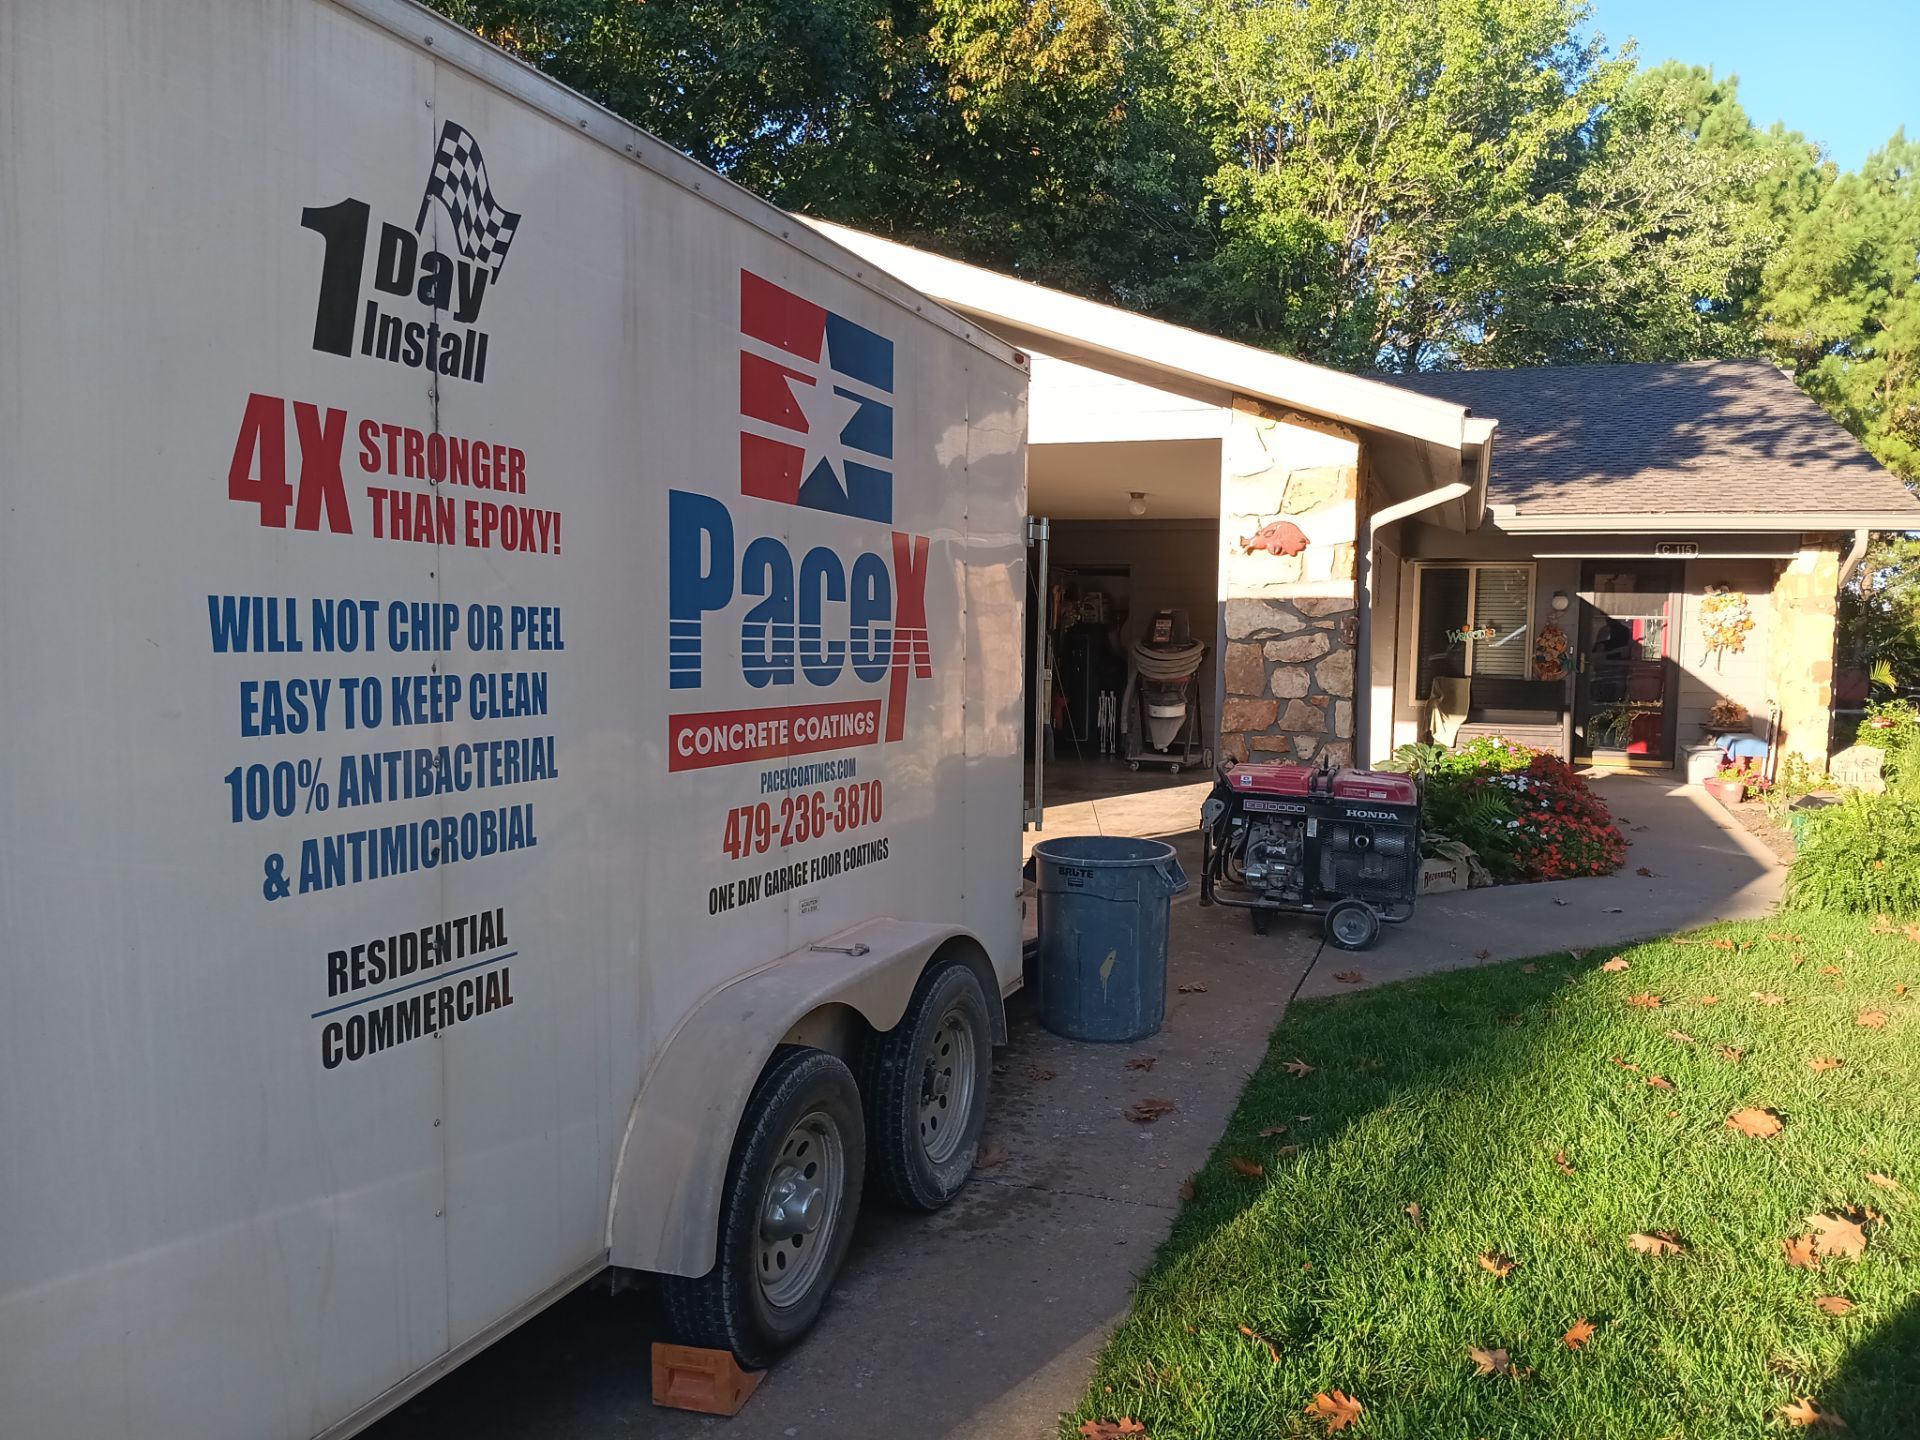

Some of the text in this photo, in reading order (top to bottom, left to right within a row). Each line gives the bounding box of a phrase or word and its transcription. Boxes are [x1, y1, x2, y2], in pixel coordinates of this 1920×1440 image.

[300, 197, 371, 358] 1
[374, 221, 490, 323] Day
[361, 300, 489, 383] Install
[228, 392, 353, 535] 4X
[358, 419, 527, 495] STRONGER
[366, 487, 562, 555] THAN EPOXY!
[207, 595, 565, 653] WILL NOT CHIP OR PEEL
[239, 671, 549, 737] EASY TO KEEP CLEAN
[677, 711, 875, 757] CONCRETE COATINGS
[224, 735, 559, 823] 100% ANTIBACTERIAL
[760, 757, 857, 794] PACEXCOATINGS.COM
[1346, 809, 1399, 820] HONDA
[262, 803, 538, 902] & ANTIMICROBIAL
[722, 779, 883, 860] 479-236-3870
[708, 837, 889, 916] ONE DAY GARAGE FLOOR COATINGS
[1058, 866, 1094, 879] BRUTE
[327, 907, 509, 998] RESIDENTIAL
[321, 966, 515, 1071] COMMERCIAL
